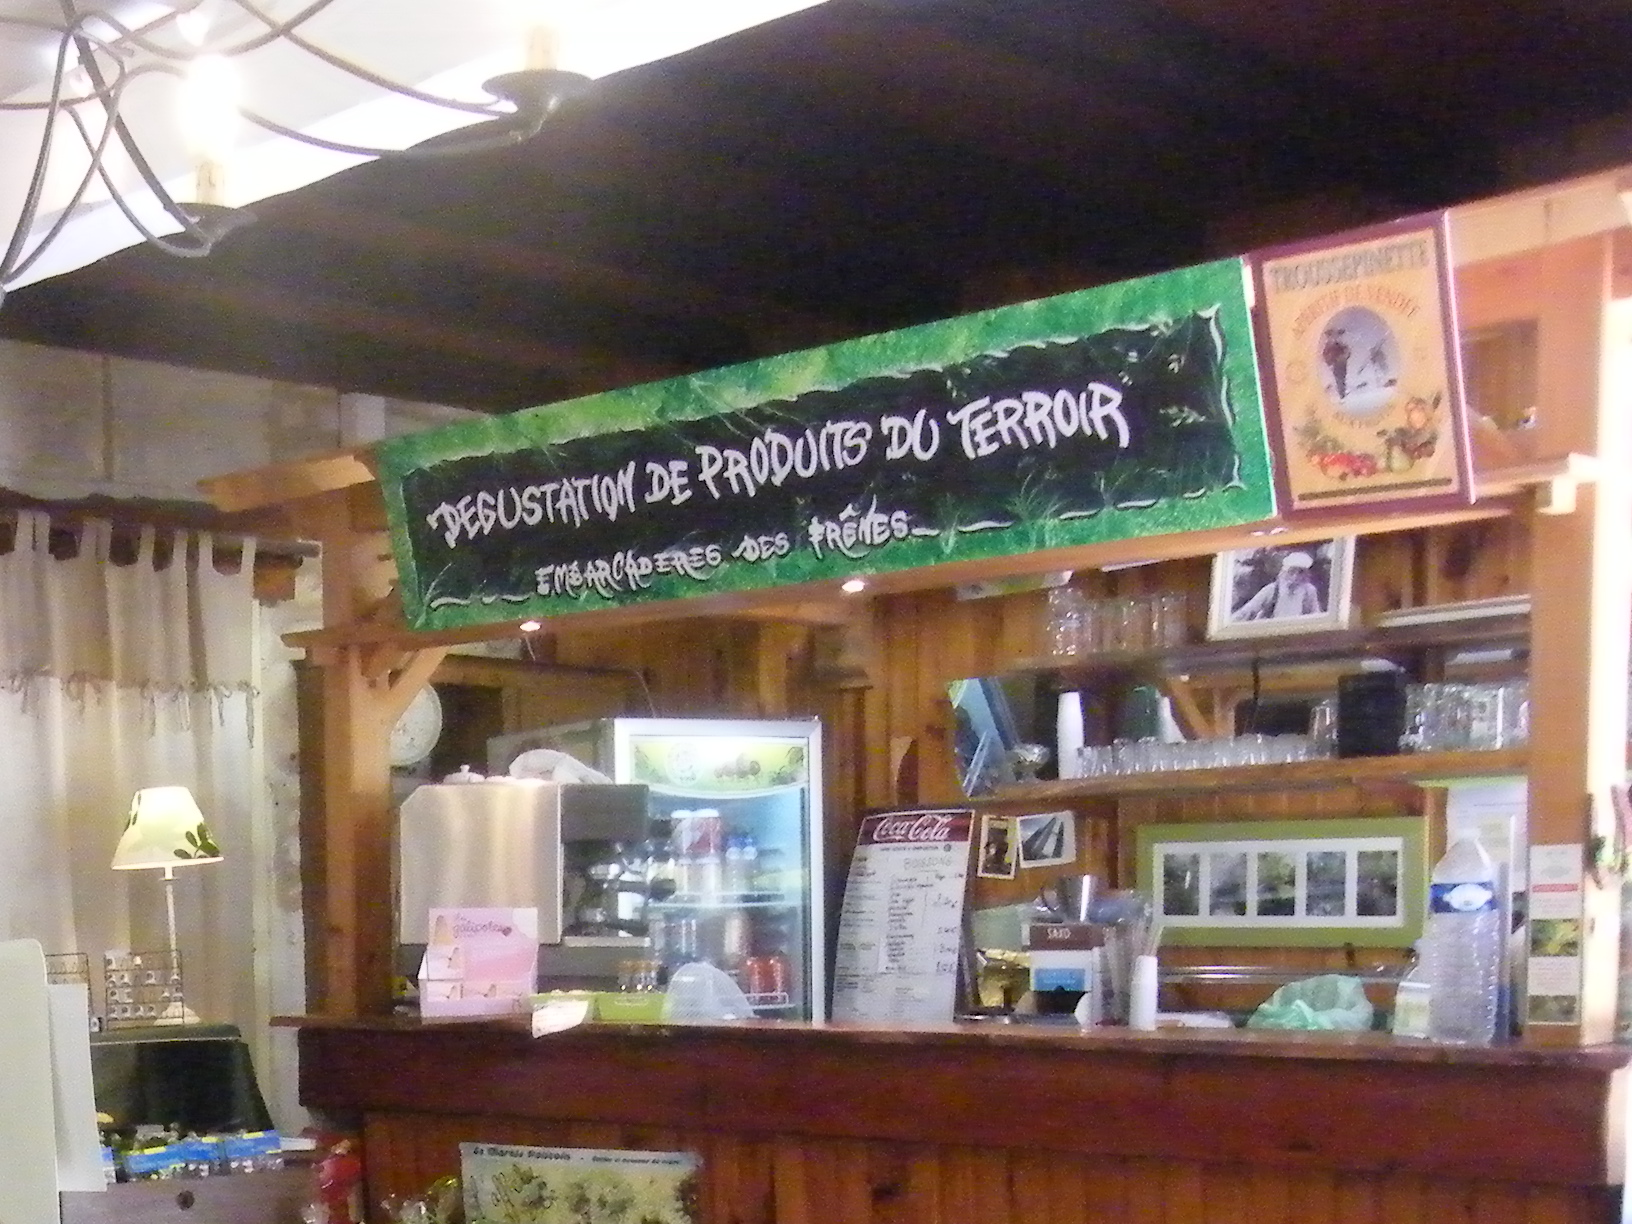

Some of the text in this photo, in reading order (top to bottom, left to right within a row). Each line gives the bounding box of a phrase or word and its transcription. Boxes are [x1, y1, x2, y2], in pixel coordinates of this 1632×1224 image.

[426, 381, 1132, 550] DEGUSTATION DE PRODUITS DU TERROIR
[731, 531, 791, 565] DES
[872, 813, 953, 842] Coca-Cola
